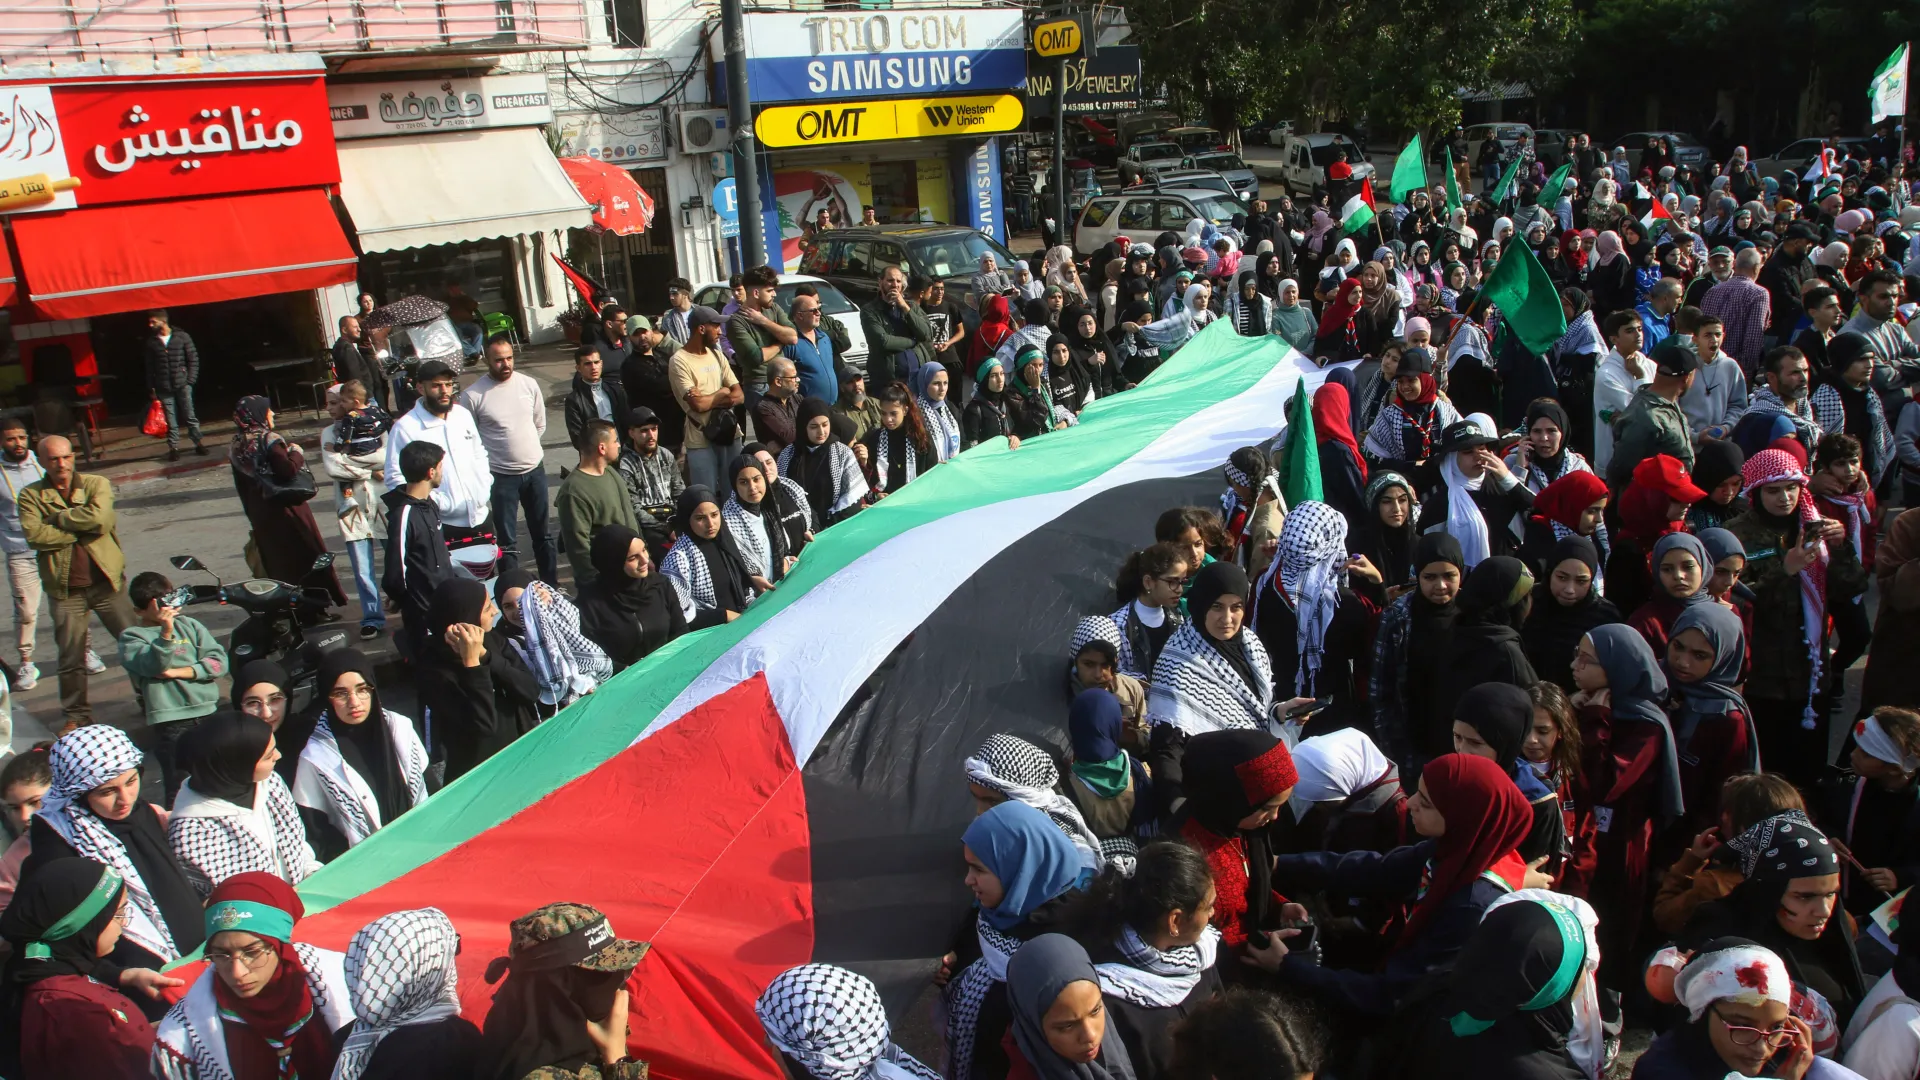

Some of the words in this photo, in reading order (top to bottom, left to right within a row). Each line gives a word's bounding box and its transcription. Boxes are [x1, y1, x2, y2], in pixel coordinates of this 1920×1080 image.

[805, 14, 891, 53] TRIO
[901, 14, 967, 50] COM
[1040, 26, 1073, 51] OMT
[807, 55, 972, 94] SAMSUNG
[495, 95, 546, 108] BREAKFAST
[956, 104, 995, 116] Western
[1102, 101, 1111, 110] 07
[796, 107, 867, 140] OMT
[956, 115, 985, 126] Union
[94, 104, 303, 173] مناقيش
